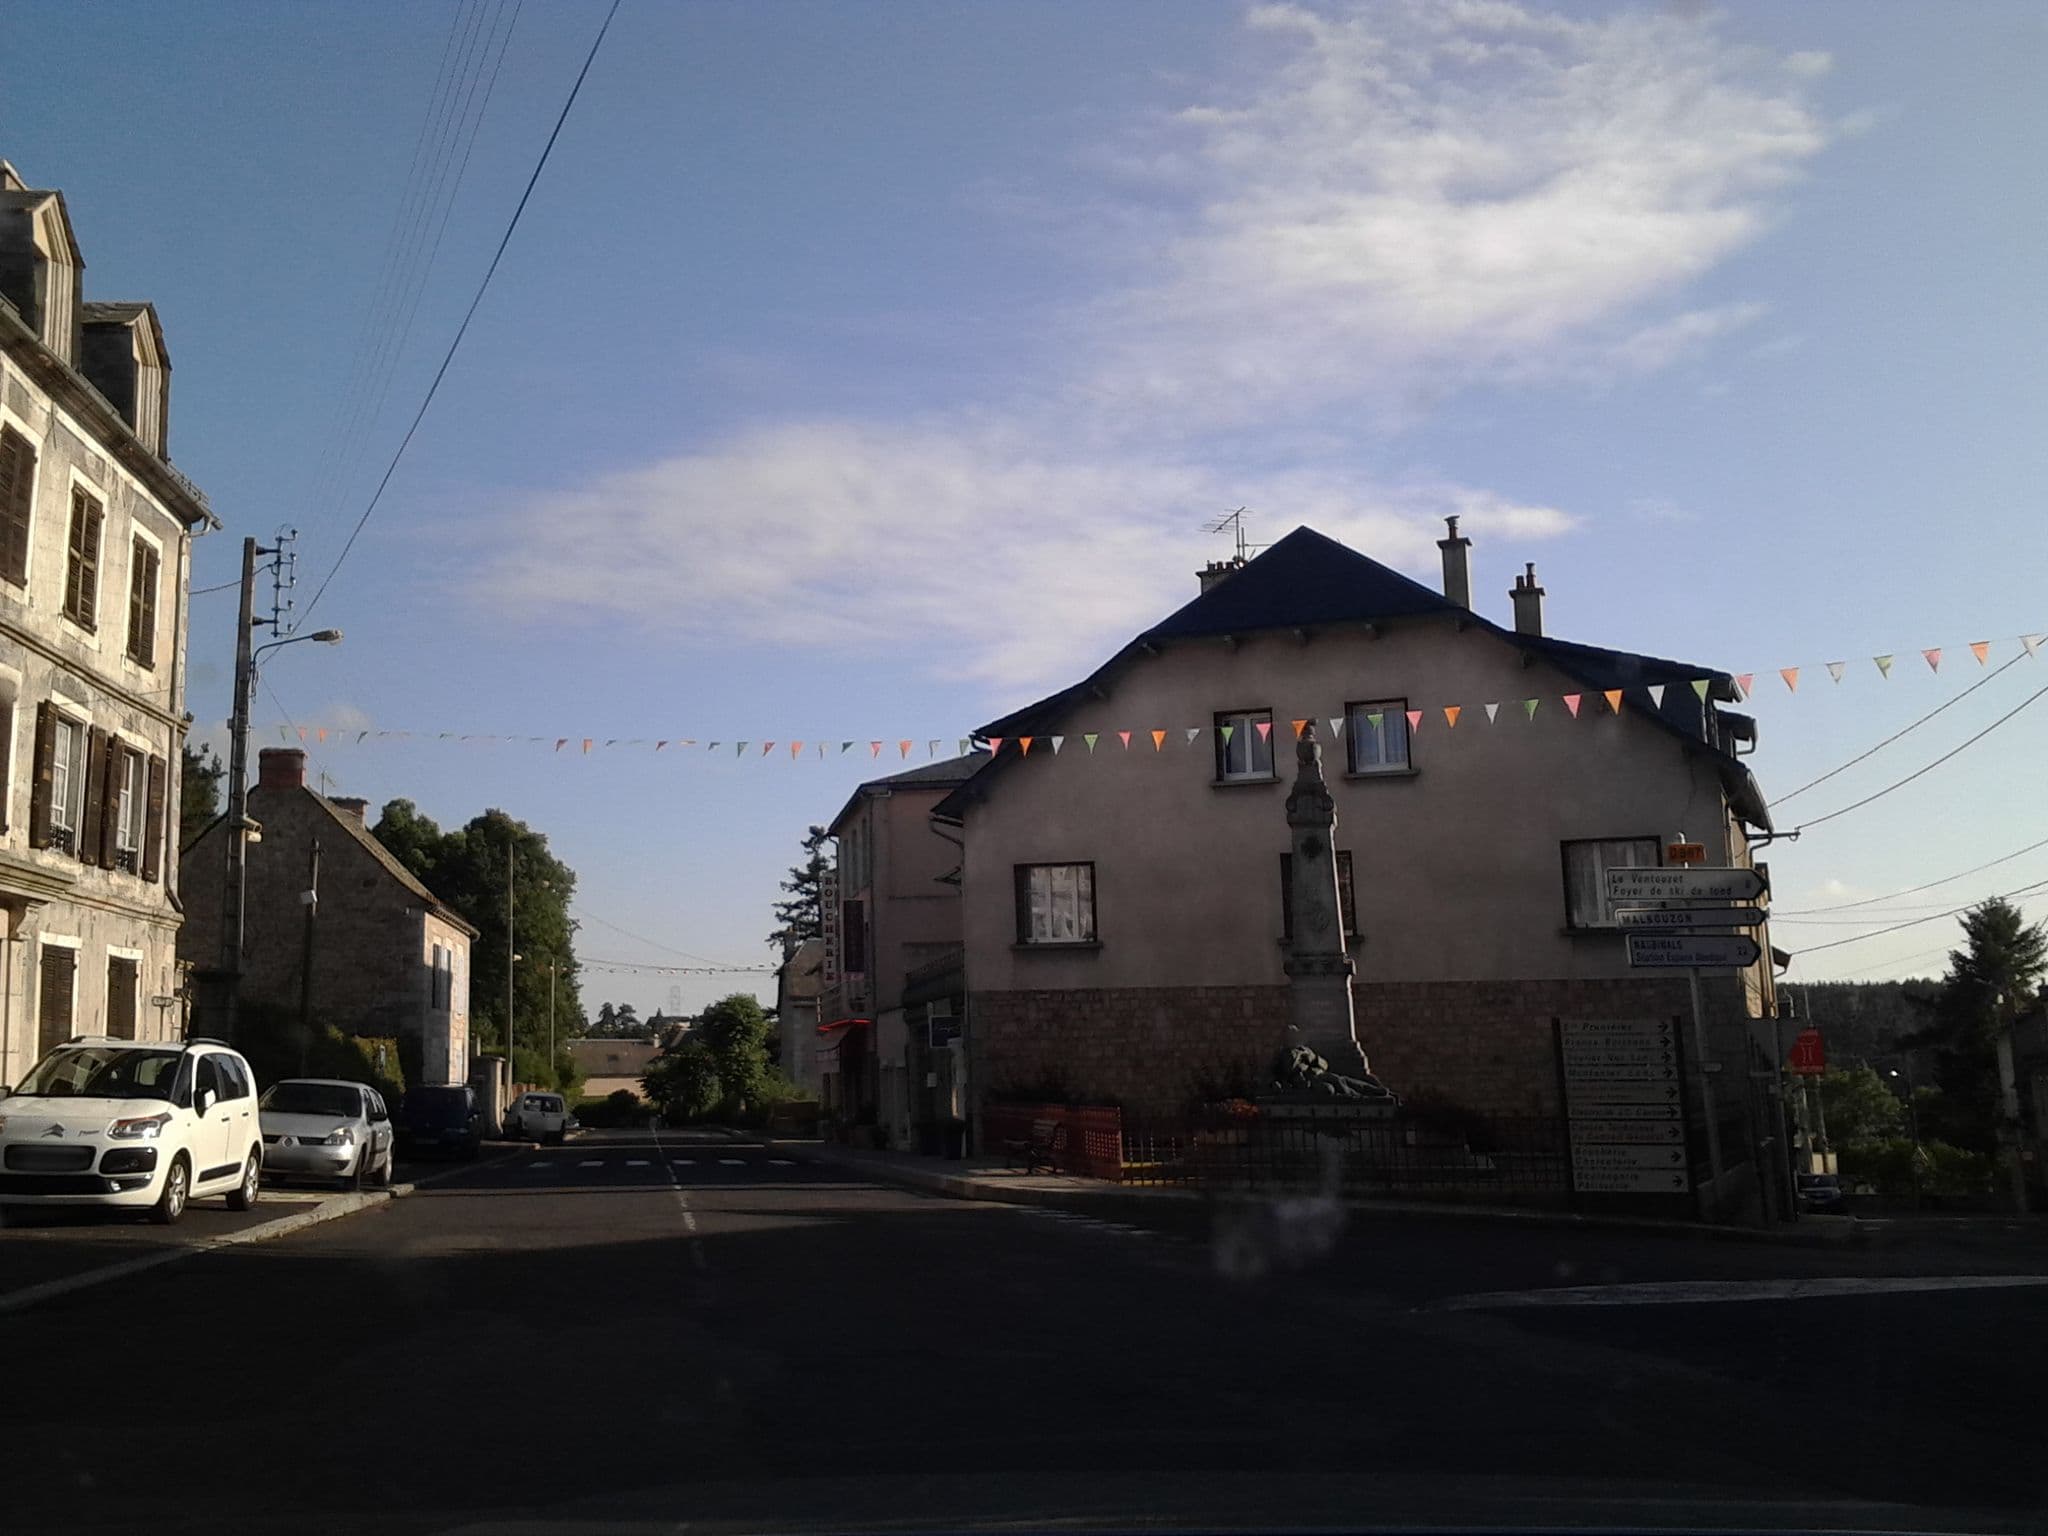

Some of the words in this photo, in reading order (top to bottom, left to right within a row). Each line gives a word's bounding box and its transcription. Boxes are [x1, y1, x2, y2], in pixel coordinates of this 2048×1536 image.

[1612, 874, 1623, 883] Le
[1613, 886, 1642, 896] Foyer
[1650, 886, 1662, 895] de
[1670, 887, 1683, 895] ski
[1691, 887, 1702, 895] de
[824, 877, 835, 981] BOUCHERIE
